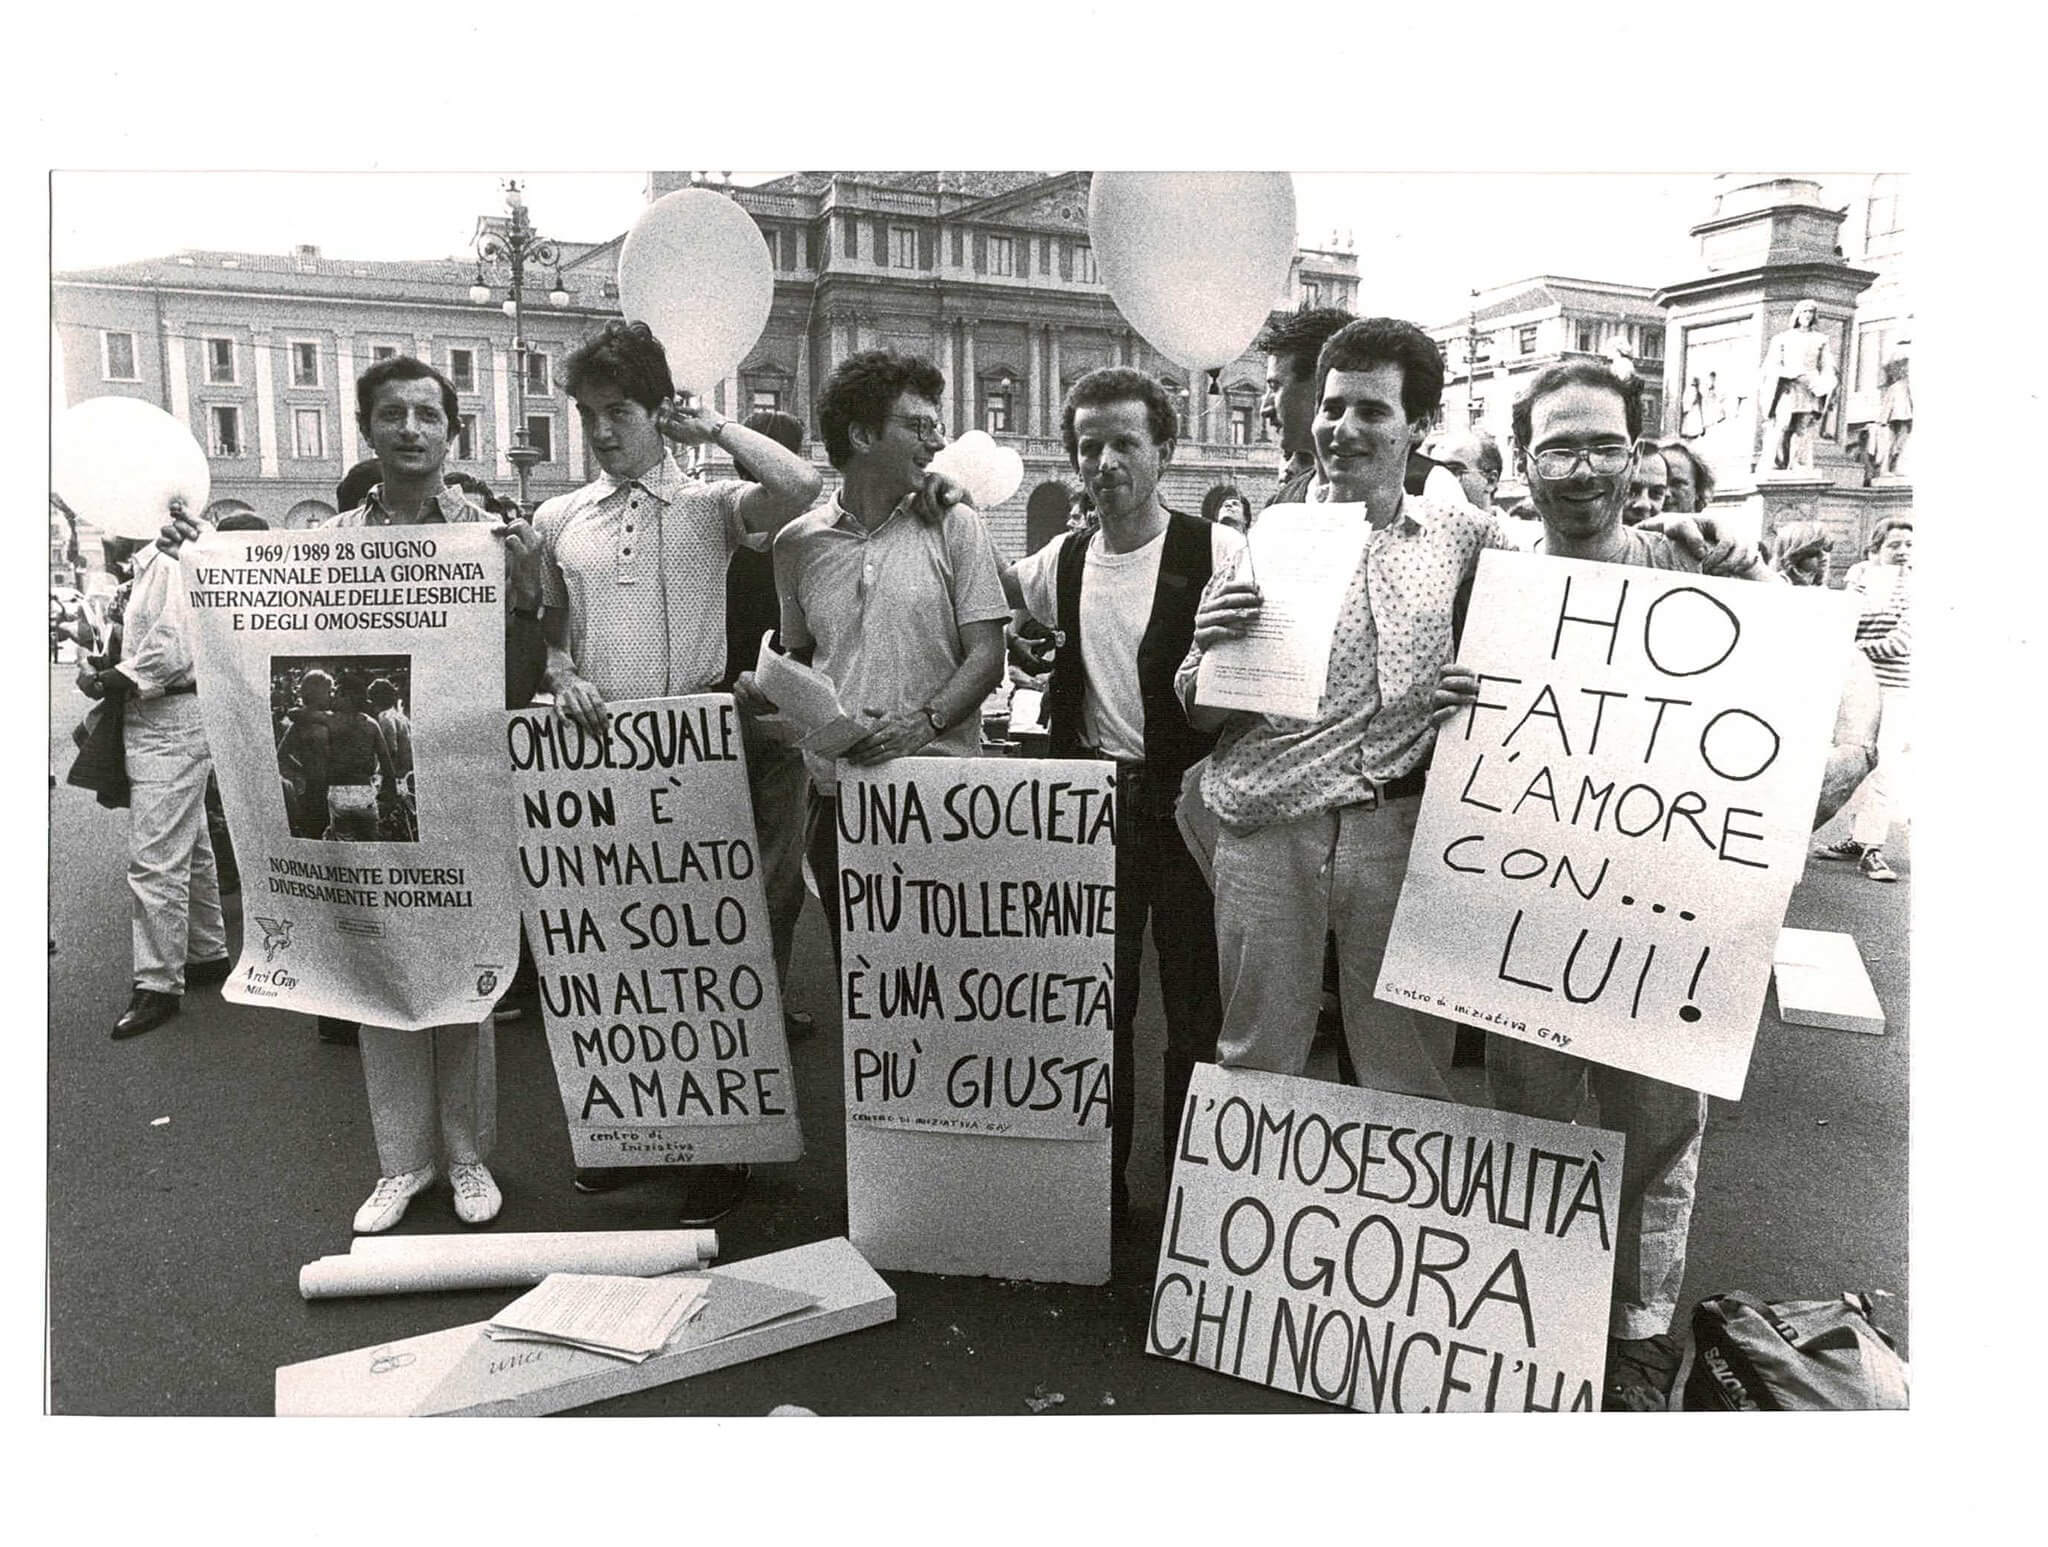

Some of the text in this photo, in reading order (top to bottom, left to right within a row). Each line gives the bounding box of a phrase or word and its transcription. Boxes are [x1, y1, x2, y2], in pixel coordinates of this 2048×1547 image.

[196, 563, 485, 585] VENTENNALE DELLA GIORNATA
[245, 540, 436, 563] 1969/1989 28 GIUGNO
[190, 586, 497, 608] INTERNAZIONALE DELLE LESBICHE
[233, 611, 448, 631] E DEGLI OMOSESSUALI
[1551, 575, 1741, 676] HO
[1465, 673, 1780, 781] FATTO
[523, 776, 682, 829] NON È
[836, 775, 1117, 846] UNA SOCIETÀ
[1461, 751, 1769, 869] L'AMORE
[269, 857, 464, 885] NORMALMENTE DIVERSI
[520, 839, 754, 888] UN MALATO
[269, 877, 473, 908] DIVERSAMENTE NORMALI
[841, 861, 1116, 939] PIÙ TOLLERANTE
[540, 897, 747, 955] HA SOLO
[272, 969, 300, 990] Gay
[540, 964, 763, 1017] UN ALTRO
[848, 954, 1114, 1031] È UNA SOCIETÀ
[1499, 908, 1715, 1024] LUI!
[572, 1019, 750, 1067] MODO DI
[581, 1068, 786, 1120] AMARE
[853, 1038, 1113, 1128] PIÙ GIUSTA
[664, 1153, 694, 1163] GAY
[1179, 1094, 1610, 1251] L'OMOSESSUALITÀ
[1167, 1185, 1536, 1349] LOGORA
[1150, 1273, 1252, 1376] CHI
